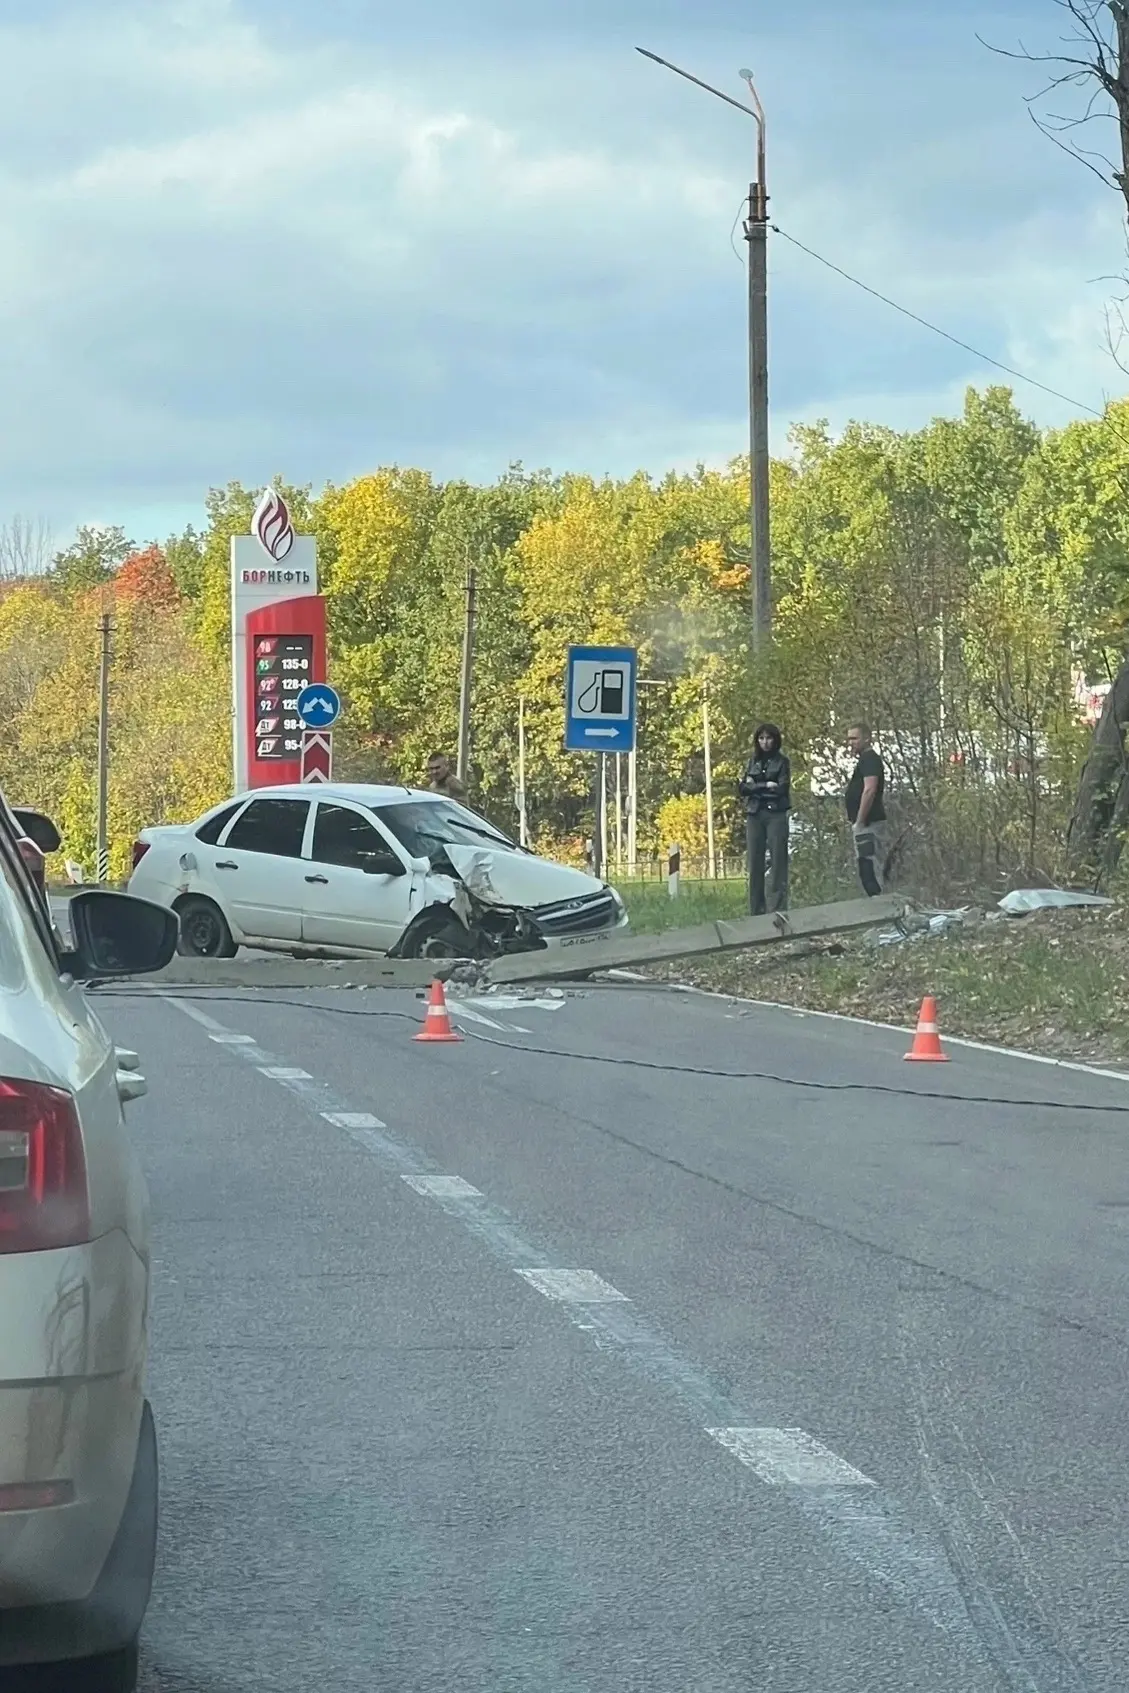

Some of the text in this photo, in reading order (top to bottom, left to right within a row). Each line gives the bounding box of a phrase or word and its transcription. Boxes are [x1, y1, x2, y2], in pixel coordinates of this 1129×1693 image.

[242, 570, 310, 584] БОРНЕФТЬ
[259, 641, 271, 653] 98
[259, 660, 269, 671] 95
[260, 699, 298, 711] 92 125
